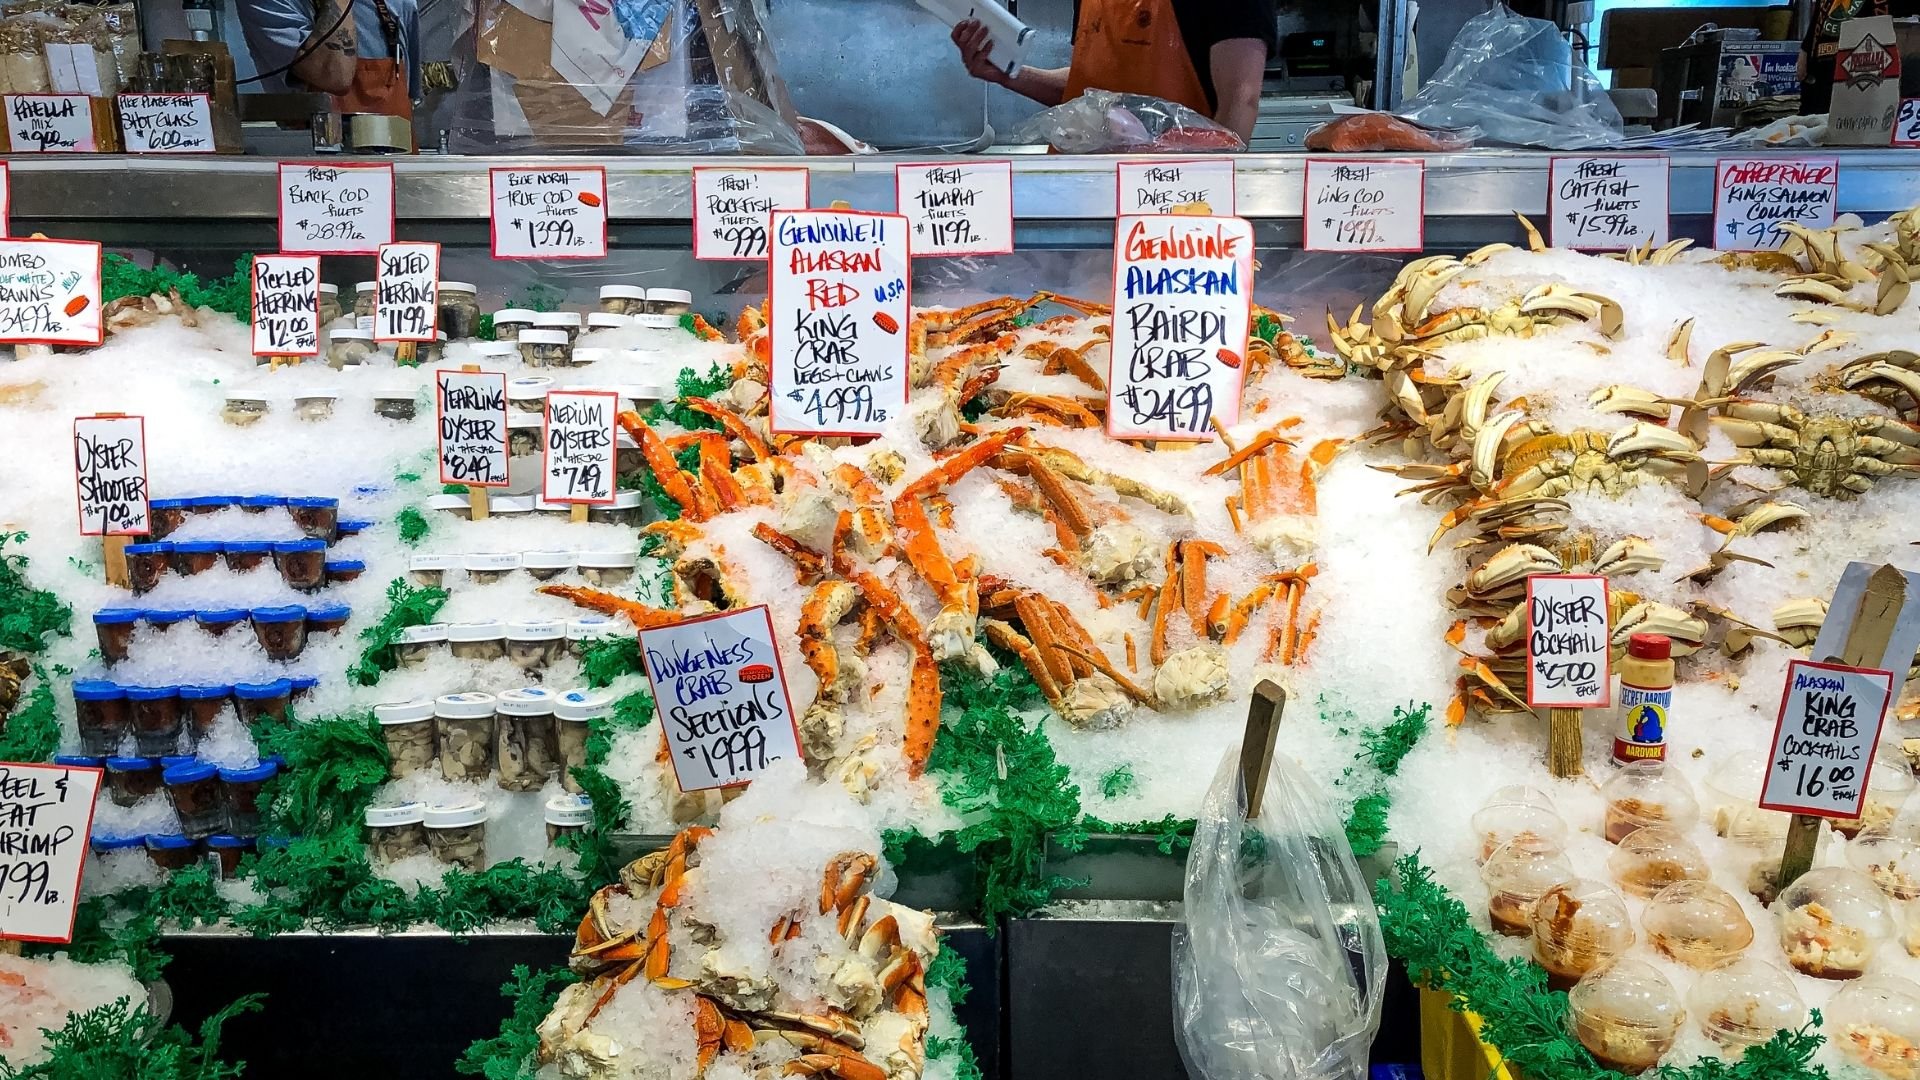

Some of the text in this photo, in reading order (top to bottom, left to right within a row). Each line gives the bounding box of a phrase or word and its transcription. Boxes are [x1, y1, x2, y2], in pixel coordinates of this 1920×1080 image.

[32, 118, 54, 130] MIX
[121, 110, 198, 130] SHOT GLASS
[508, 173, 534, 186] BLUE
[289, 186, 369, 204] BLACK COD
[498, 192, 573, 207] TRUE COD
[1138, 189, 1174, 210] DOVER
[1177, 189, 1210, 204] SOLE
[1316, 185, 1384, 205] LING COD
[1728, 184, 1834, 204] KING SALMON
[1746, 202, 1822, 221] COLLARS
[1124, 221, 1244, 262] GENUINE
[380, 248, 430, 277] SALTED
[790, 248, 882, 274] ALASKAN
[1124, 259, 1238, 299] ALASKAN
[0, 285, 54, 303] RAWNS
[252, 290, 317, 316] HERRING
[379, 280, 434, 305] HERRING
[804, 278, 860, 311] RED
[794, 308, 858, 344] KING
[1126, 303, 1227, 346] BAIRDI
[794, 340, 860, 370] CRAB
[1129, 347, 1212, 384] CRAB
[438, 378, 506, 412] YEARLING
[548, 402, 603, 428] MEDIUM
[440, 415, 505, 444] OYSTER
[550, 426, 610, 458] OYSTERS
[74, 432, 138, 480] OYSTER
[446, 444, 455, 454] IN
[554, 454, 563, 466] IN
[79, 472, 148, 504] SHOOTER
[121, 514, 145, 530] EACH
[1532, 596, 1604, 632] OYSTER
[1530, 629, 1605, 657] COCKTAIL
[646, 636, 753, 684] DUNGENESS
[676, 669, 732, 706] CRAB
[1576, 684, 1600, 697] EACH
[1795, 673, 1844, 692] ALASKAN
[1622, 688, 1644, 706] SECRET
[1805, 692, 1856, 718] KING
[670, 684, 783, 742] SECTIONS
[1802, 714, 1858, 738] CRAB
[1626, 744, 1662, 758] AARDVARK
[1783, 734, 1860, 760] COCKTAILS
[1832, 789, 1858, 802] EACH
